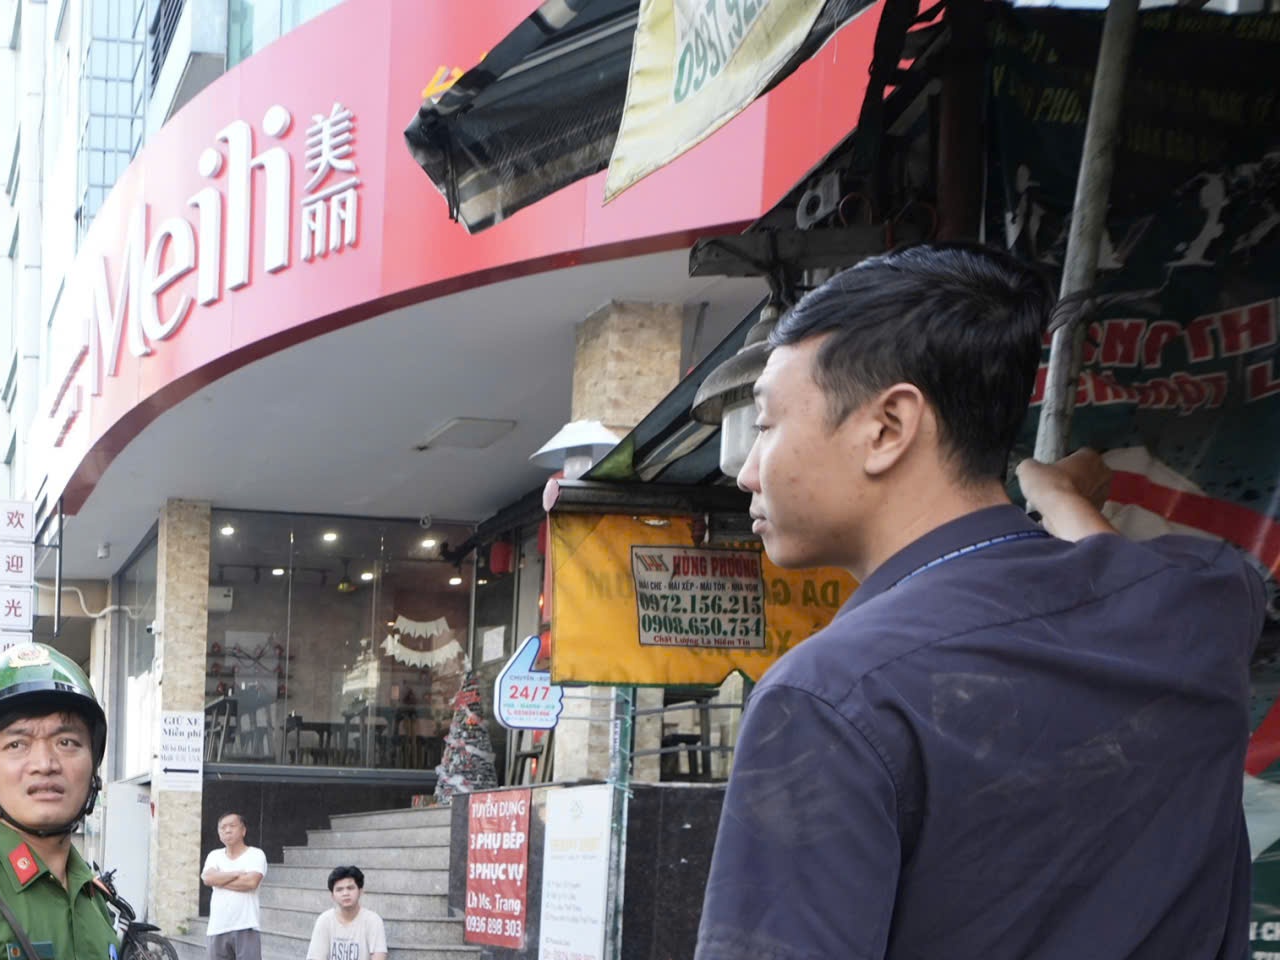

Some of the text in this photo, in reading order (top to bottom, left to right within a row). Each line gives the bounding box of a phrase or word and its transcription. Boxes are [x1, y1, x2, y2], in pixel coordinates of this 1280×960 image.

[300, 102, 363, 263] 美丽
[89, 104, 292, 397] Meili
[639, 593, 762, 616] 0972.156.215
[641, 615, 762, 637] 0908.650.754
[509, 685, 550, 702] 24/7
[499, 799, 526, 820] DỤNG
[477, 831, 502, 854] PHỤ
[502, 819, 526, 850] BẾP
[508, 863, 525, 886] VỤ
[494, 894, 522, 916] Trang
[466, 916, 487, 932] 0936
[504, 919, 523, 937] 303
